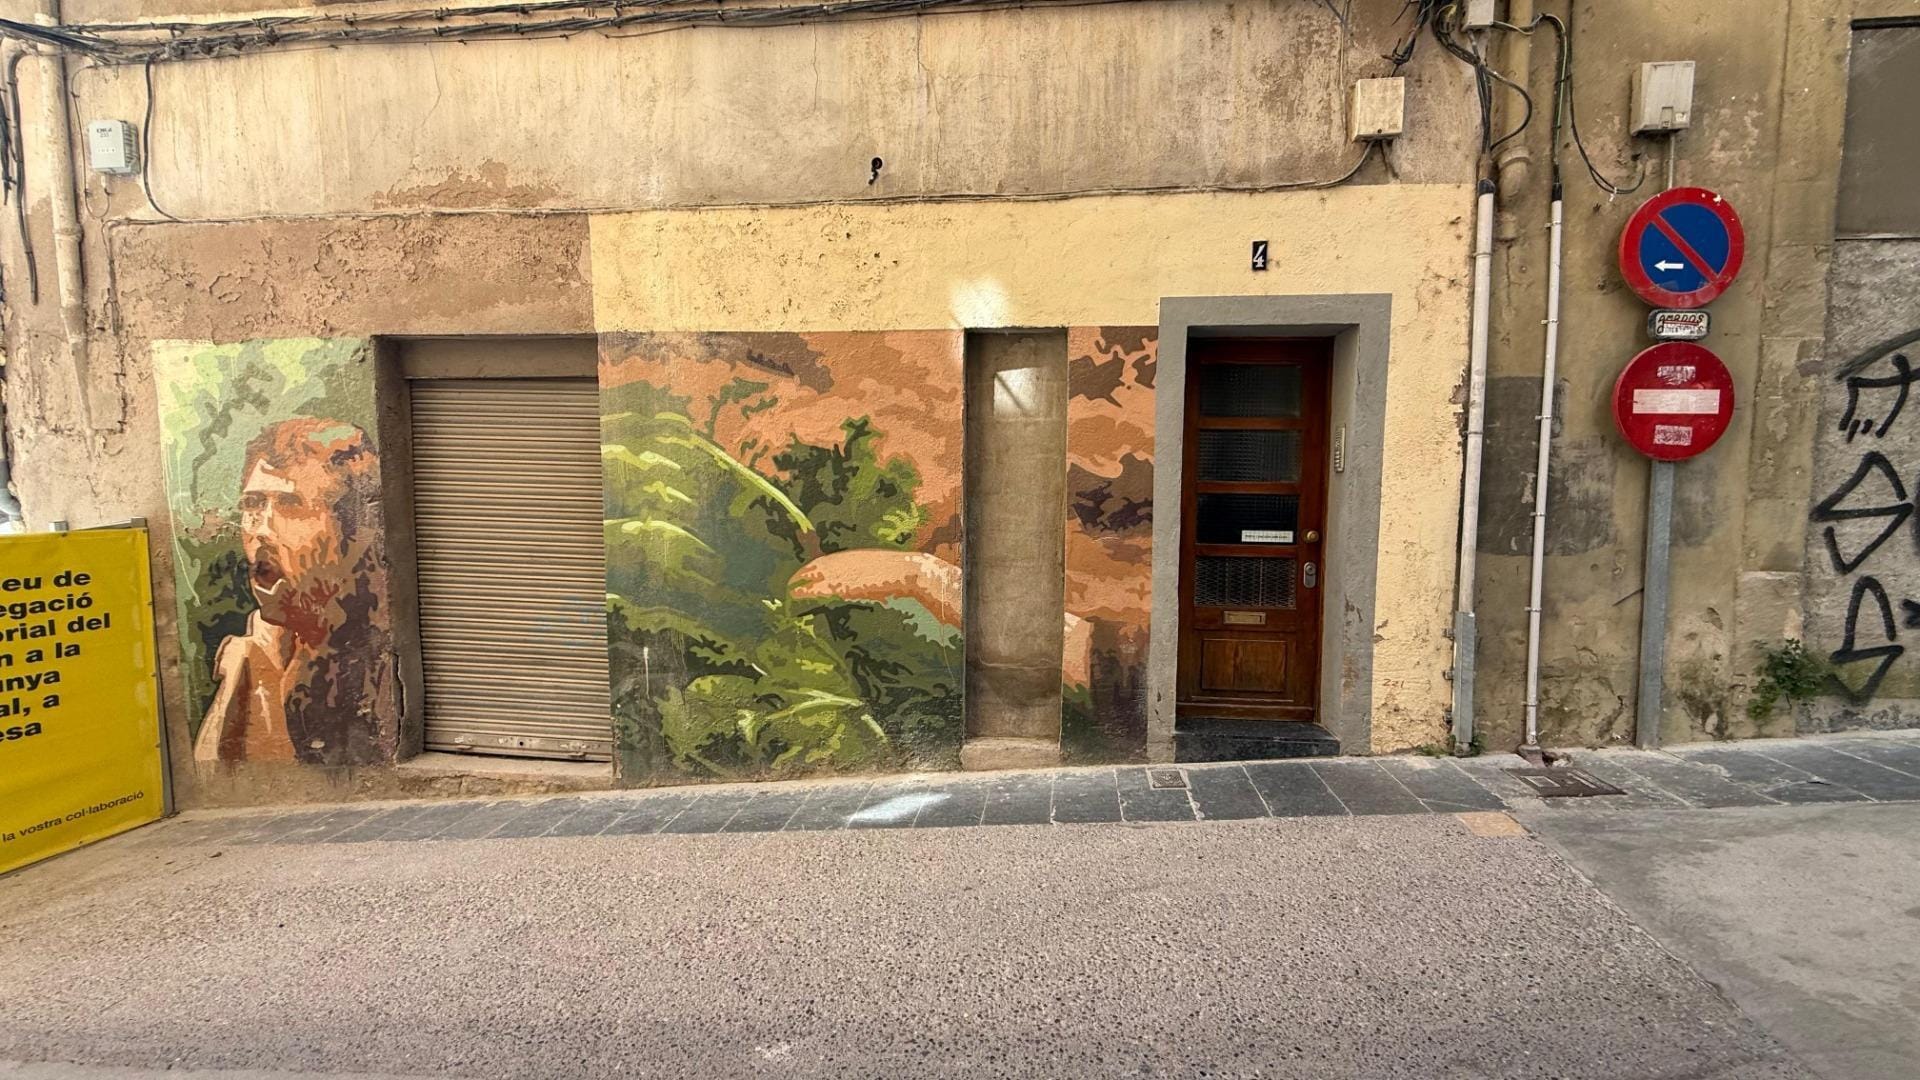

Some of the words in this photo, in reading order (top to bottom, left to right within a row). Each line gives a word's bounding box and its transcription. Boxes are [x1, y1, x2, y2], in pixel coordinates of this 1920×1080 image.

[1253, 244, 1266, 268] 4
[1, 576, 42, 592] eu
[53, 570, 91, 588] de
[0, 619, 56, 642] rial
[67, 612, 110, 633] del
[26, 649, 43, 663] a
[55, 642, 80, 658] la
[0, 670, 61, 693] nya
[42, 694, 60, 709] a
[0, 722, 42, 742] sa
[2, 832, 16, 842] la
[19, 816, 62, 836] vostra
